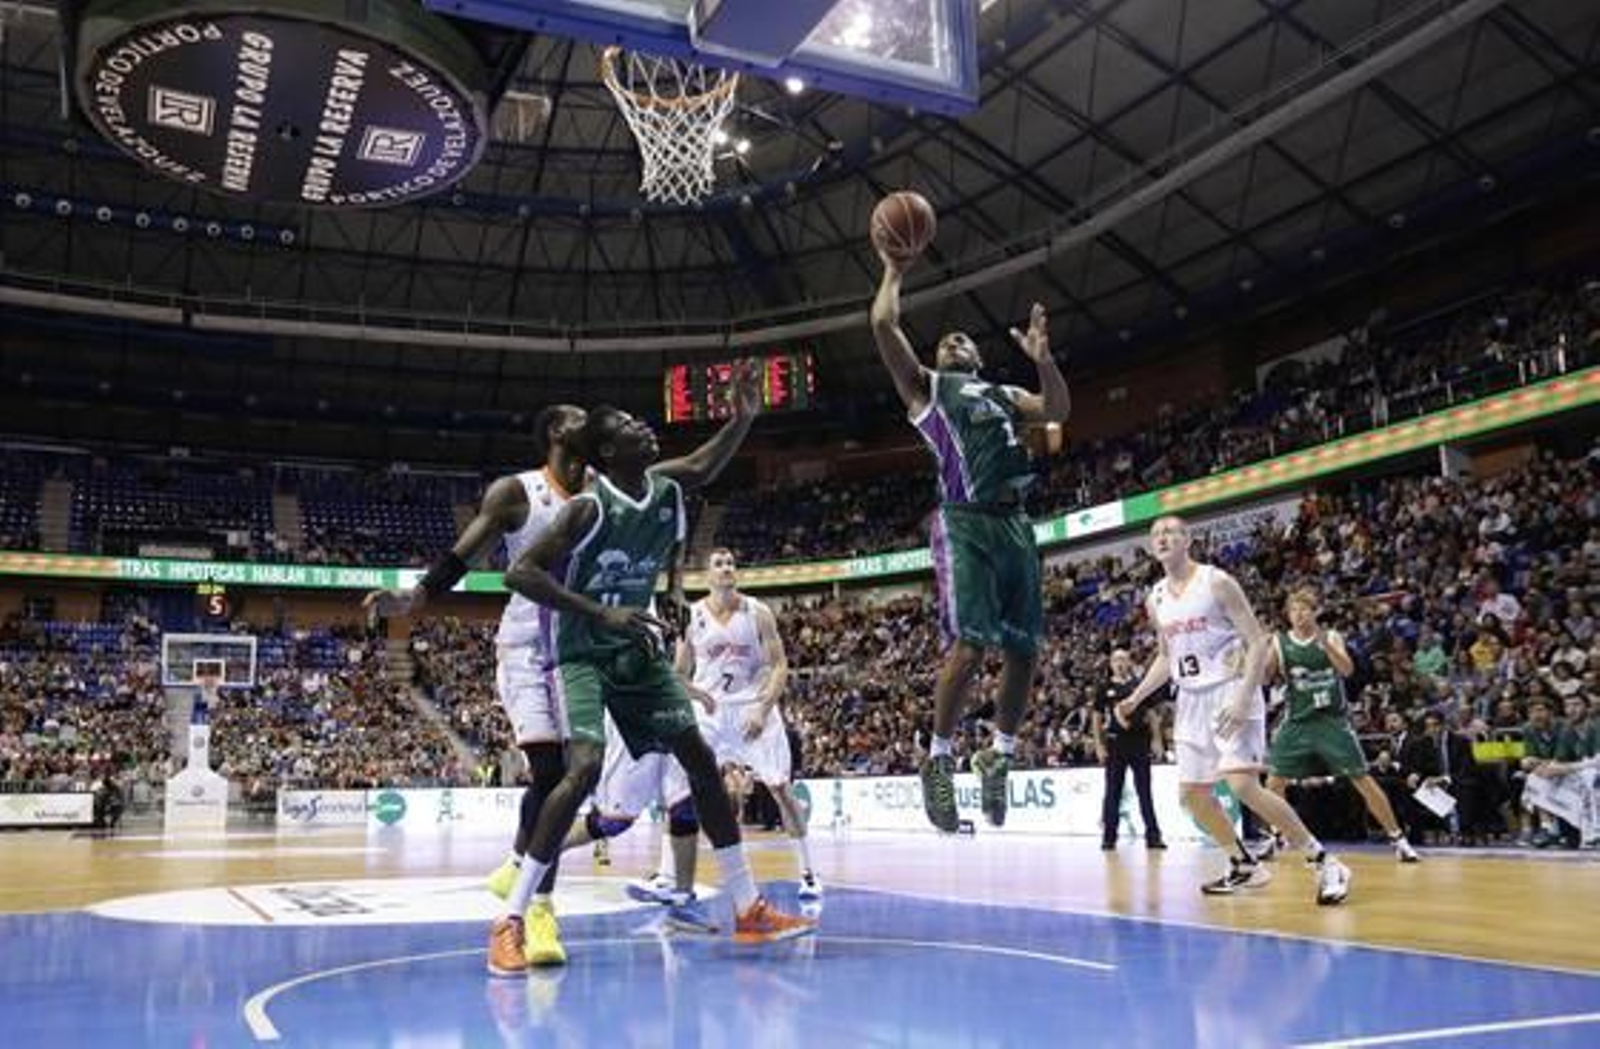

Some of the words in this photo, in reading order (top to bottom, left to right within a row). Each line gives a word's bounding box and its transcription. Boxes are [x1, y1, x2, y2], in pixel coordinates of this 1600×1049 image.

[107, 23, 222, 72] PORTICO
[235, 31, 274, 103] GRUPO
[319, 49, 369, 134] RESERVA
[231, 104, 263, 129] LA
[313, 135, 344, 156] LA
[301, 156, 337, 201] GRUPO
[169, 562, 246, 584] HIPOTECAS
[252, 566, 306, 584] HABLAN
[313, 568, 333, 585] TU
[1178, 653, 1201, 678] 13
[721, 672, 735, 692] 7
